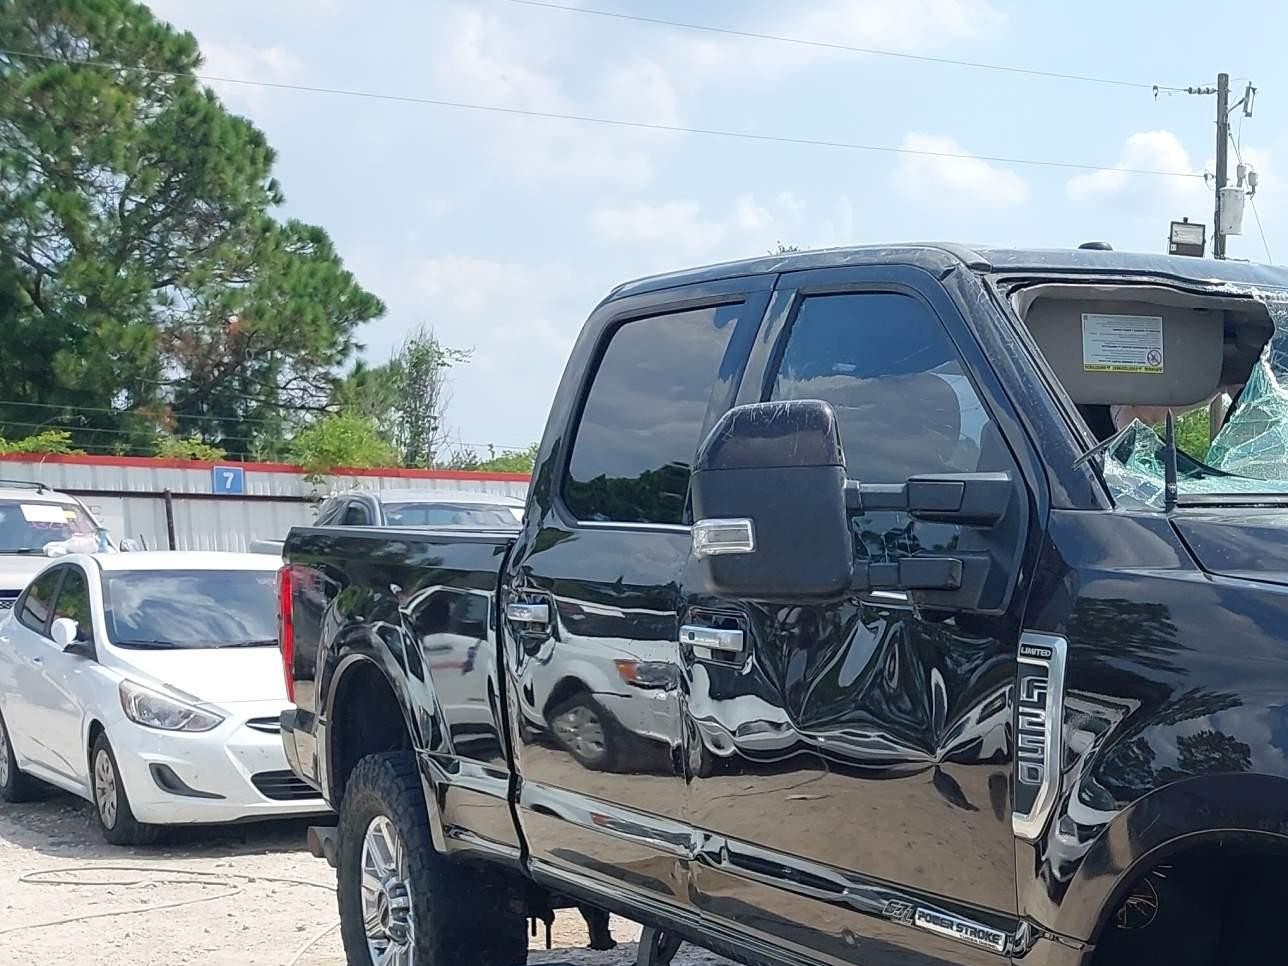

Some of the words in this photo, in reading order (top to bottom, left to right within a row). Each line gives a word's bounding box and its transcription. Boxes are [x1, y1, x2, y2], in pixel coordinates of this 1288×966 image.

[223, 471, 235, 489] 7
[1020, 646, 1052, 657] LIMITED
[917, 910, 954, 931] POWER
[955, 922, 1002, 945] STROKE
